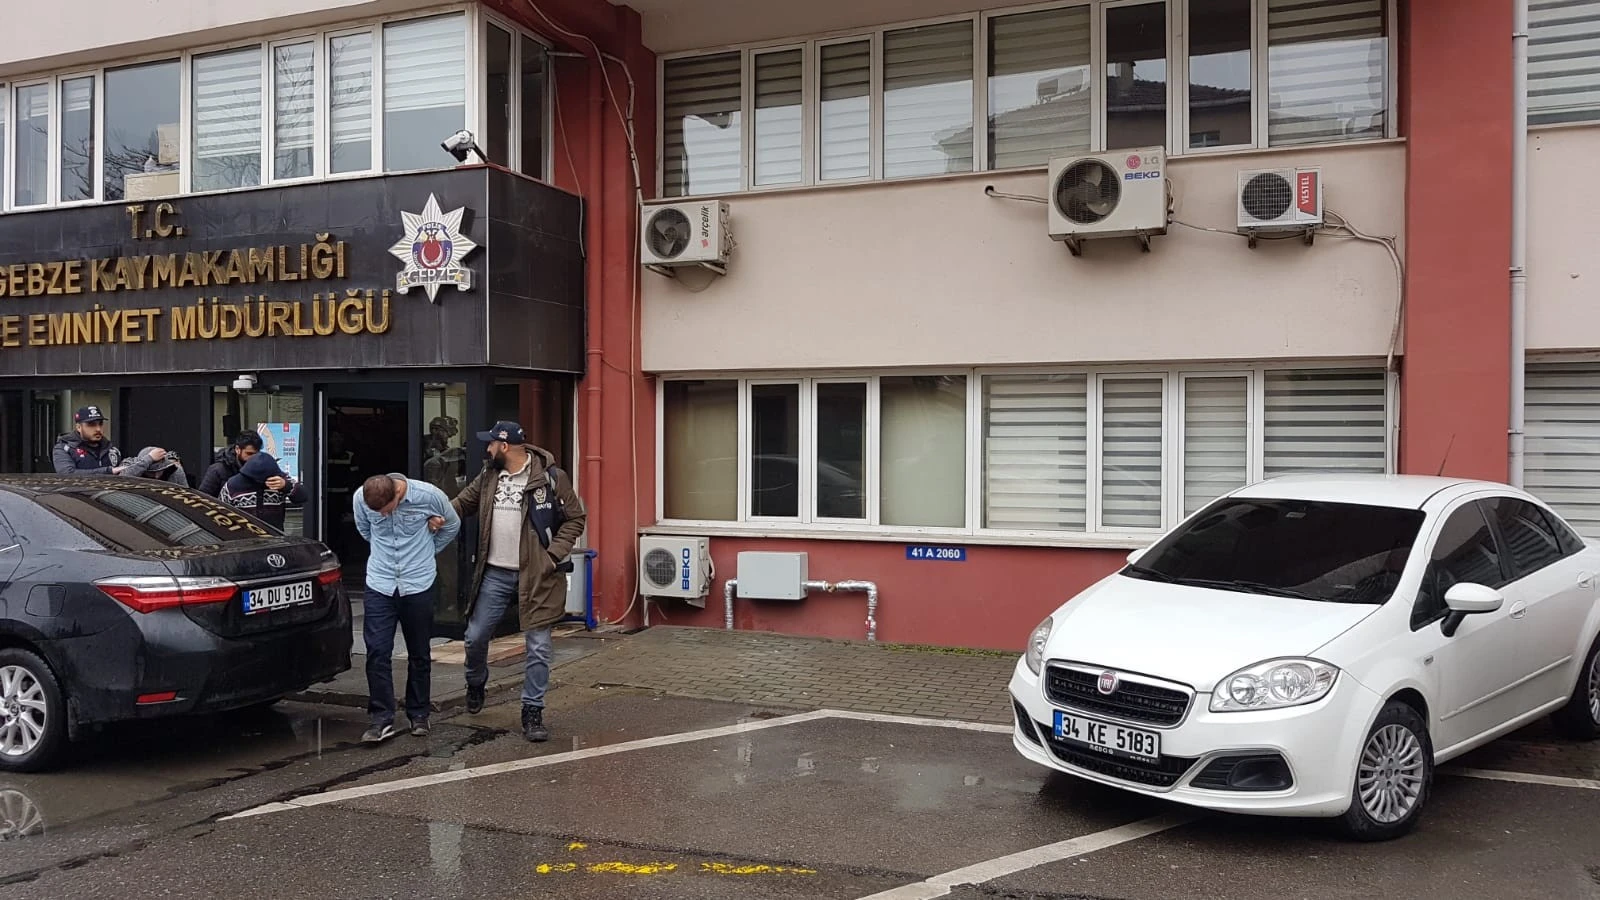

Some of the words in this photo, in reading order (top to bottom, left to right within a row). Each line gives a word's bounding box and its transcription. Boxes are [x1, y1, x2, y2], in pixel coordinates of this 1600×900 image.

[1124, 171, 1160, 180] BEKO
[1144, 157, 1159, 165] LG
[1301, 176, 1309, 205] VESTEL
[126, 203, 183, 239] T.C.
[701, 206, 711, 238] arçelik
[91, 232, 345, 292] KAYMAKAMLIĞI
[408, 267, 460, 284] GEBZE
[29, 303, 161, 346] EMNİYET
[171, 288, 391, 340] MÜDÜRLÜĞÜ
[911, 547, 923, 558] 41
[925, 548, 934, 558] A
[936, 548, 960, 559] 2060
[682, 548, 690, 590] BEKO
[250, 591, 264, 608] 34
[268, 588, 281, 605] DU
[285, 584, 310, 602] 9126
[1063, 716, 1079, 738] 34
[1088, 722, 1107, 745] KE
[1116, 728, 1154, 755] 5183
